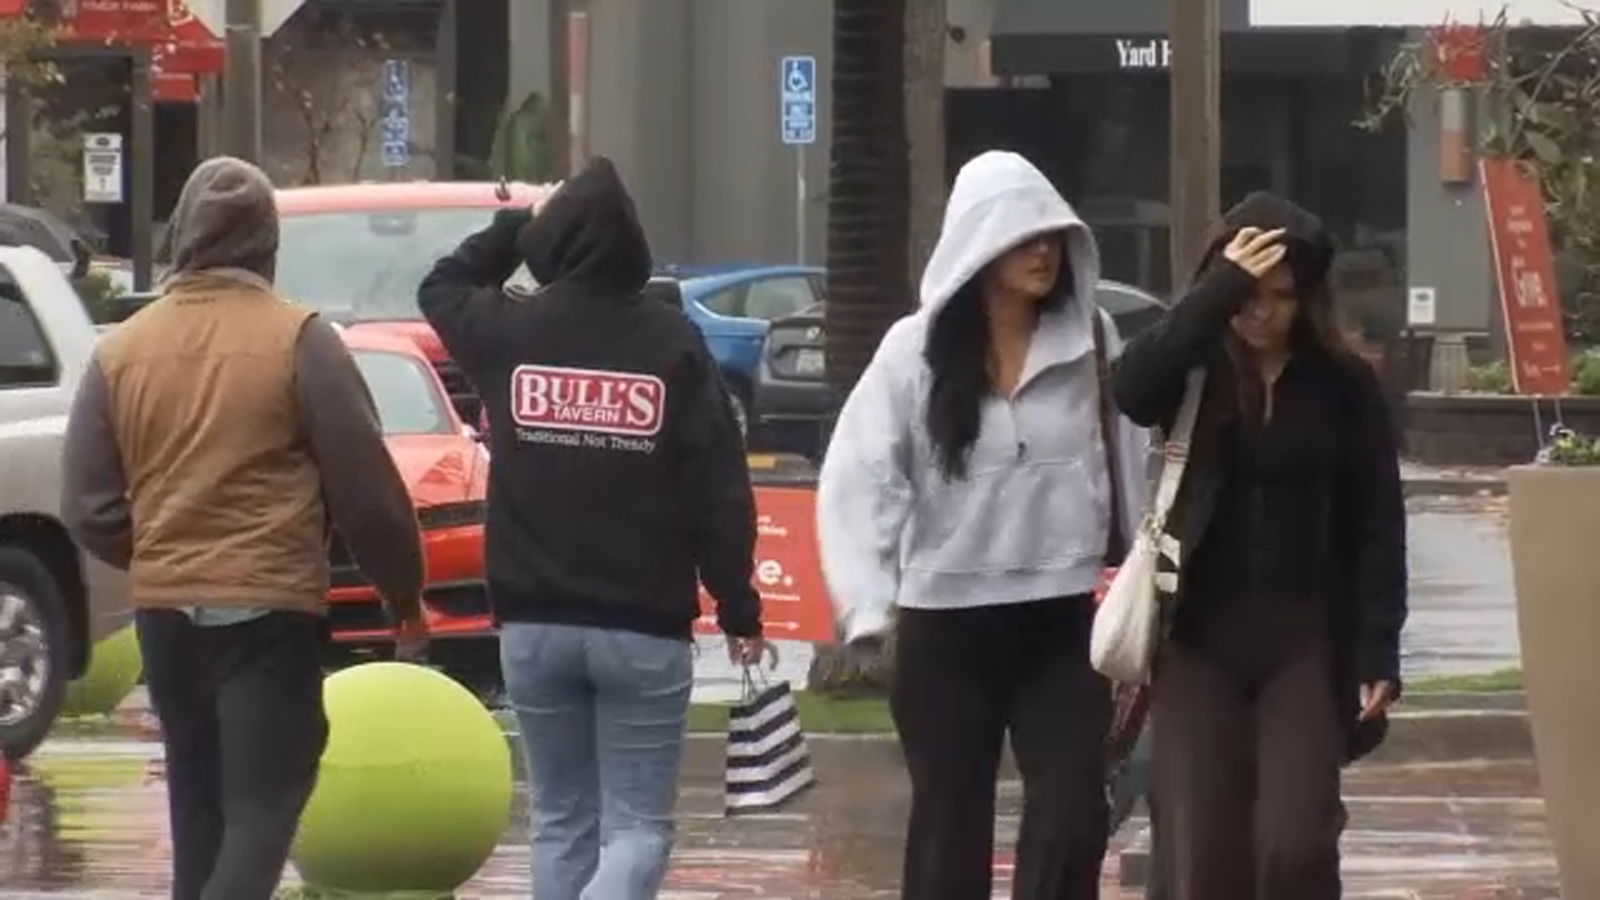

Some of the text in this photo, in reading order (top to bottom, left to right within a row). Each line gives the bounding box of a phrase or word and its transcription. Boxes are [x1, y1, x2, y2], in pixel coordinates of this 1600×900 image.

[1116, 39, 1156, 67] Yard
[519, 373, 656, 426] BULL'S
[551, 405, 620, 423] TAVERN
[514, 428, 655, 454] Traditional Not Trendy
